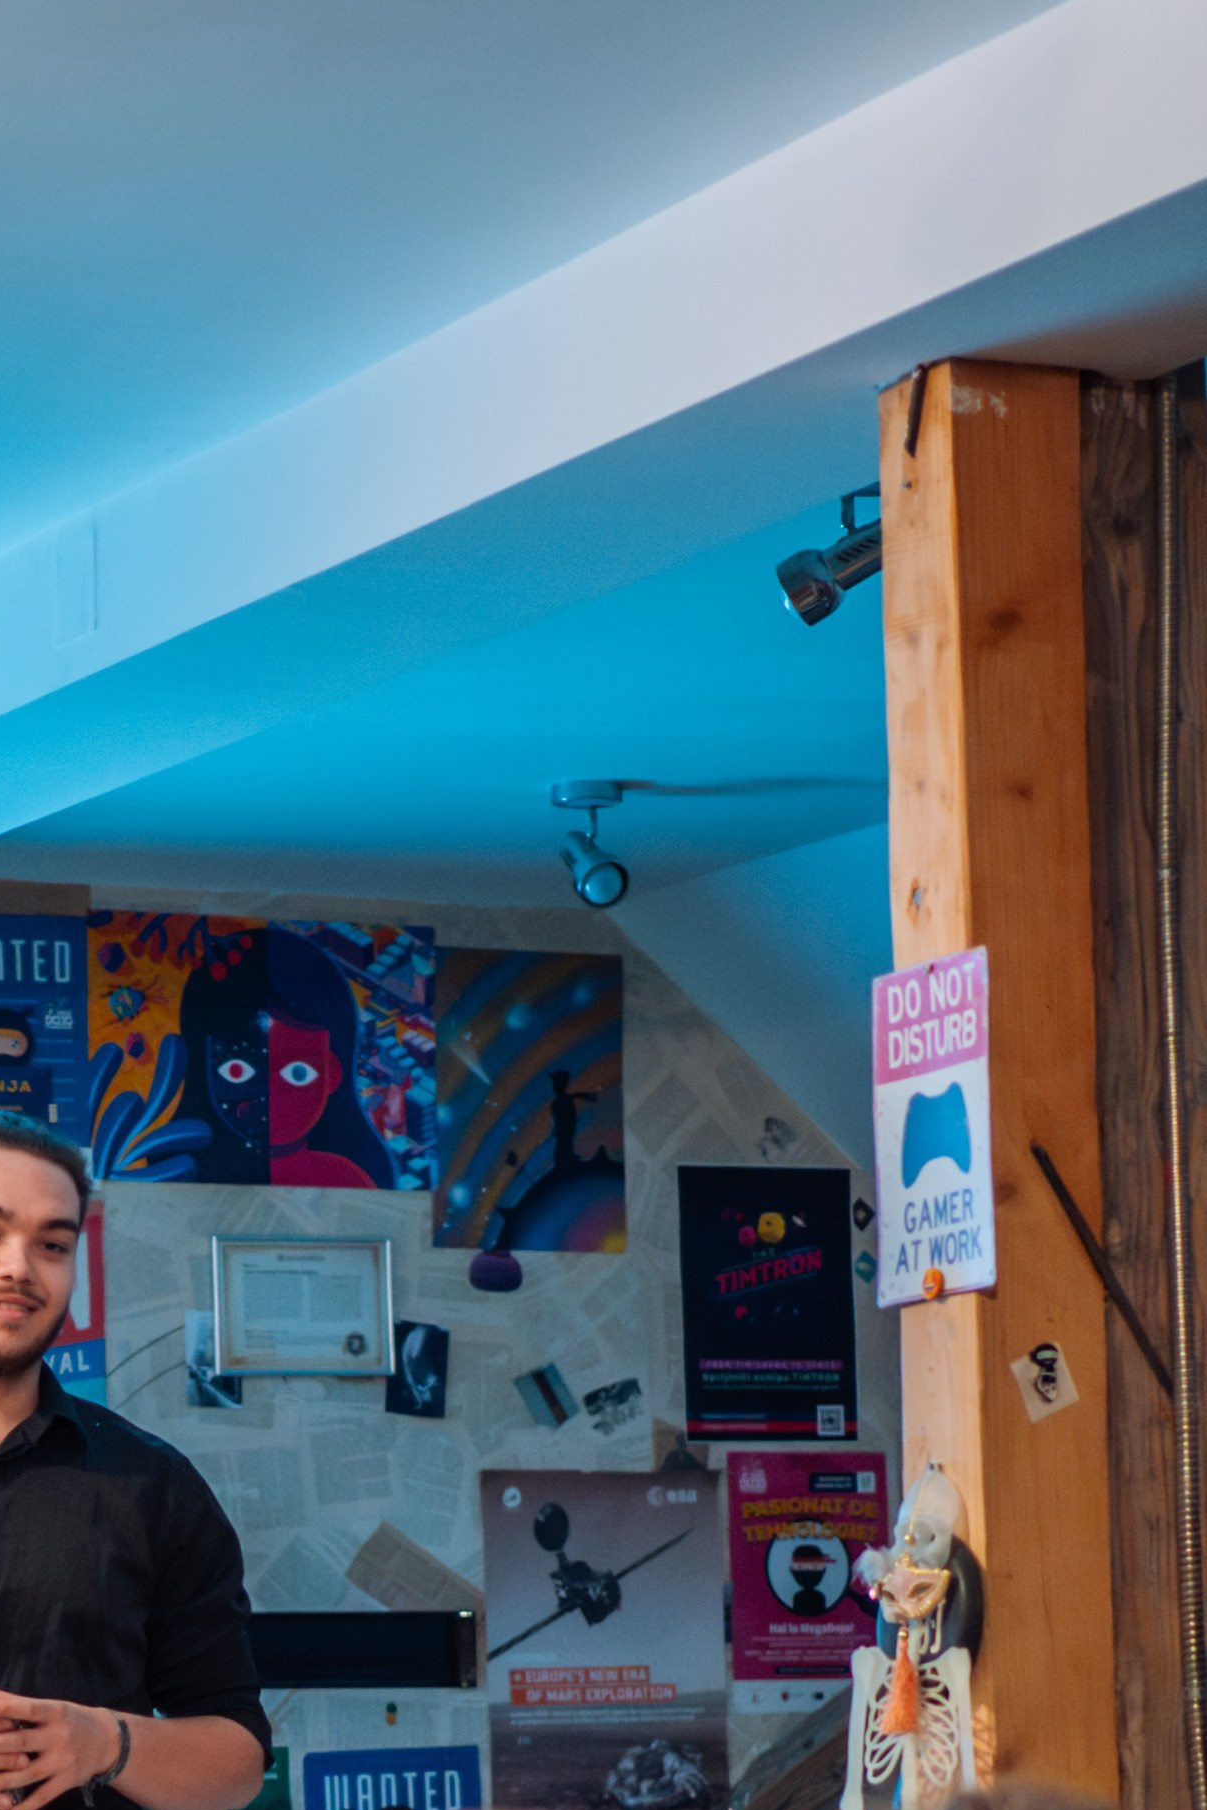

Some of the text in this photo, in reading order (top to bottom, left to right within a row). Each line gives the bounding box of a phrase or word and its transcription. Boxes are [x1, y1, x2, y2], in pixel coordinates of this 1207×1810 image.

[887, 961, 976, 1025] DO NOT
[888, 1008, 978, 1070] DISTURB
[903, 1187, 974, 1235] GAMER
[715, 1247, 823, 1296] TIMTRON
[894, 1225, 983, 1276] AT WORK
[742, 1497, 877, 1519] PASIONAT DE
[525, 1667, 647, 1683] EUROPE'S NEW ERA
[526, 1683, 674, 1702] OF MARS EXPLORATION
